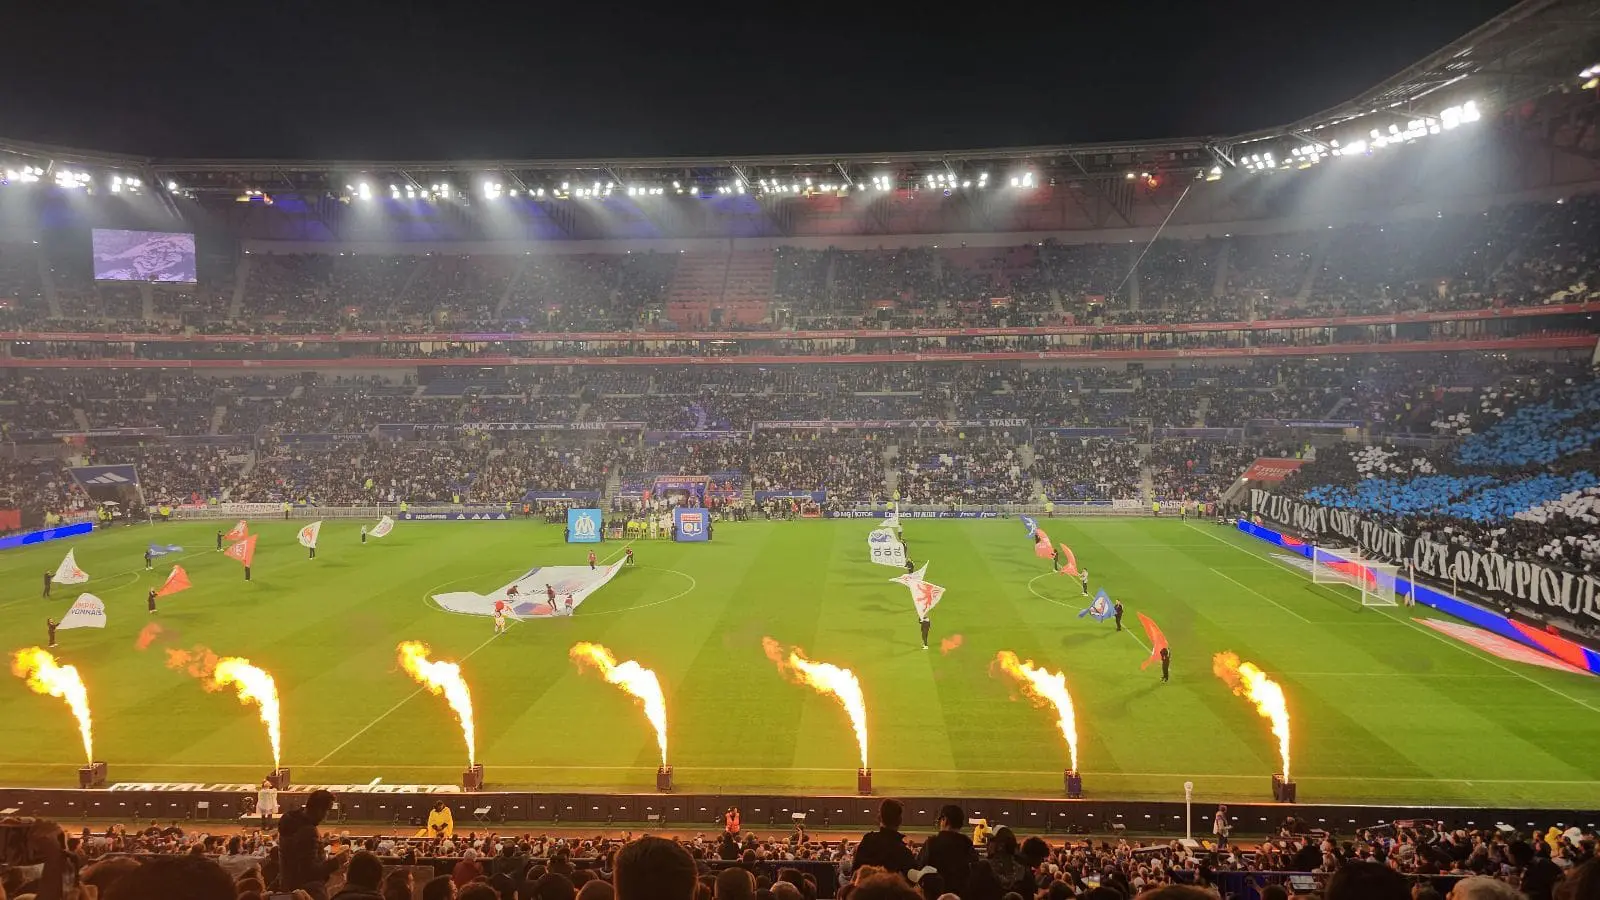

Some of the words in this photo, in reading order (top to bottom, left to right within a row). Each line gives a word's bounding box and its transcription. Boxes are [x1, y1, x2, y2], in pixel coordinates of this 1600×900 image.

[570, 422, 607, 430] STANLEY
[989, 419, 1027, 427] STANLEY
[1250, 488, 1292, 525] PLUS
[1413, 537, 1449, 577] CET
